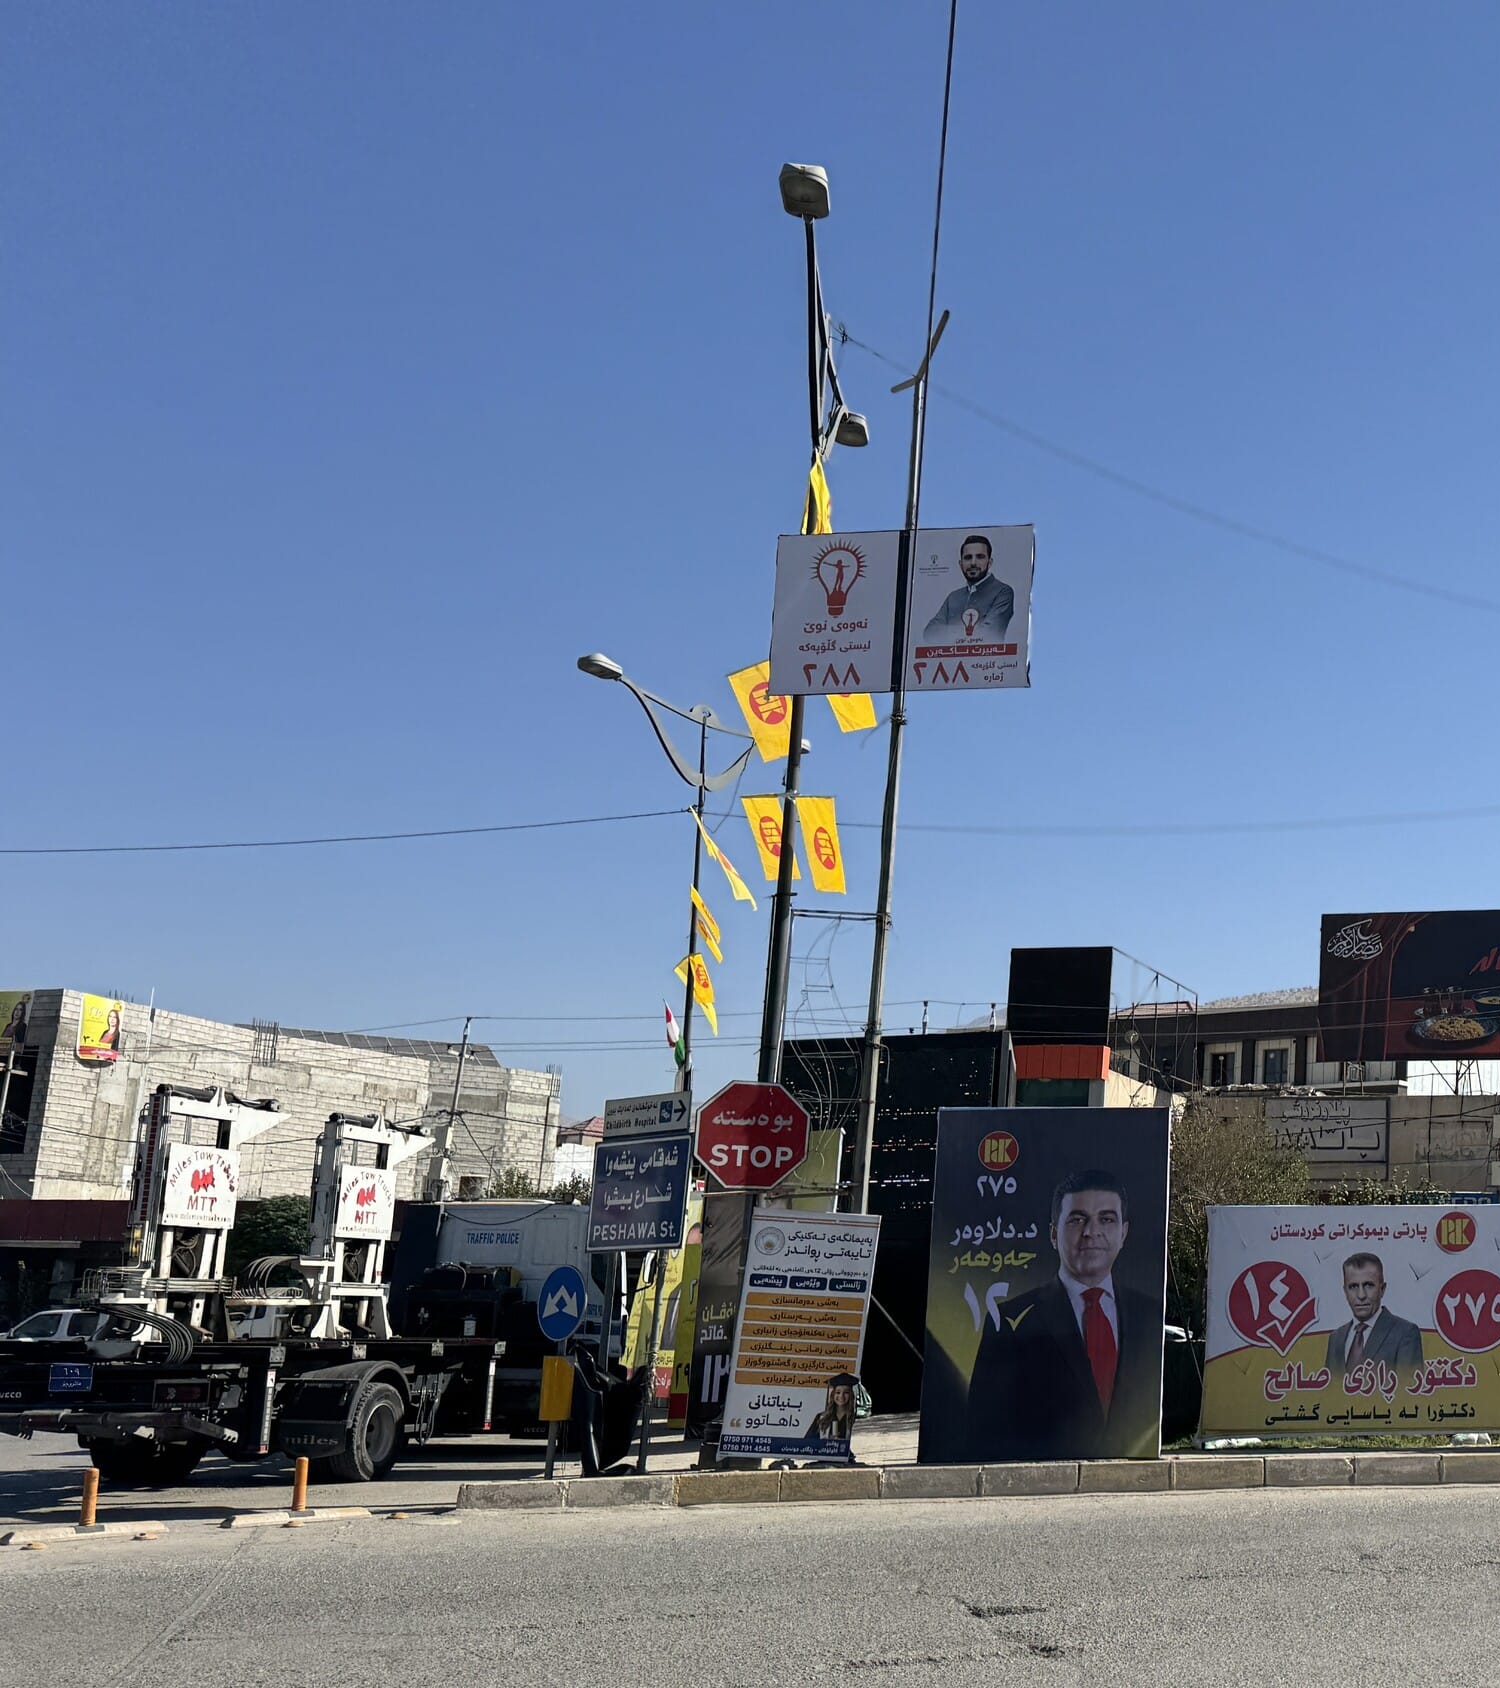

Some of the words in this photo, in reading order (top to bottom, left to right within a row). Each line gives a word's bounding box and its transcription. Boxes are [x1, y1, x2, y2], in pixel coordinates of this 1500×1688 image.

[804, 620, 827, 634] نوێ
[831, 619, 868, 632] نەوەی
[840, 640, 871, 652] لیستی
[803, 662, 861, 688] ٢٨٨
[913, 661, 970, 684] ٢٨٨
[984, 672, 1004, 683] ژمارە
[606, 1119, 632, 1130] Childbirth
[635, 1116, 656, 1128] Hospital
[605, 1150, 636, 1180] پێشەوا
[639, 1146, 679, 1174] شەقامی
[710, 1144, 794, 1168] STOP
[634, 1182, 672, 1210] شارع
[976, 1174, 1018, 1198] ٢٧٥
[187, 1195, 218, 1212] MTT
[354, 1210, 378, 1225] MTT
[466, 1230, 494, 1244] TRAFFIC
[496, 1232, 520, 1244] POLICE
[592, 1221, 656, 1241] PESHAWA
[660, 1220, 676, 1238] St.
[827, 1232, 873, 1247] پەیمانگەی
[1270, 1224, 1325, 1240] کوردستان
[1329, 1224, 1390, 1240] دیموکراتی
[1393, 1222, 1428, 1243] پارتی
[948, 1250, 1037, 1274] جەوهەر
[1243, 1269, 1292, 1322] ١٤
[964, 1281, 1010, 1332] ١٢
[1265, 1363, 1330, 1401] صالح
[1408, 1358, 1477, 1394] دکتۆر
[0, 1391, 22, 1399] VECO
[1265, 1403, 1320, 1426] گشتی
[1326, 1404, 1391, 1426] یاسایی
[1400, 1405, 1419, 1419] لە
[1427, 1402, 1476, 1422] دکتۆرا
[285, 1435, 339, 1446] miles
